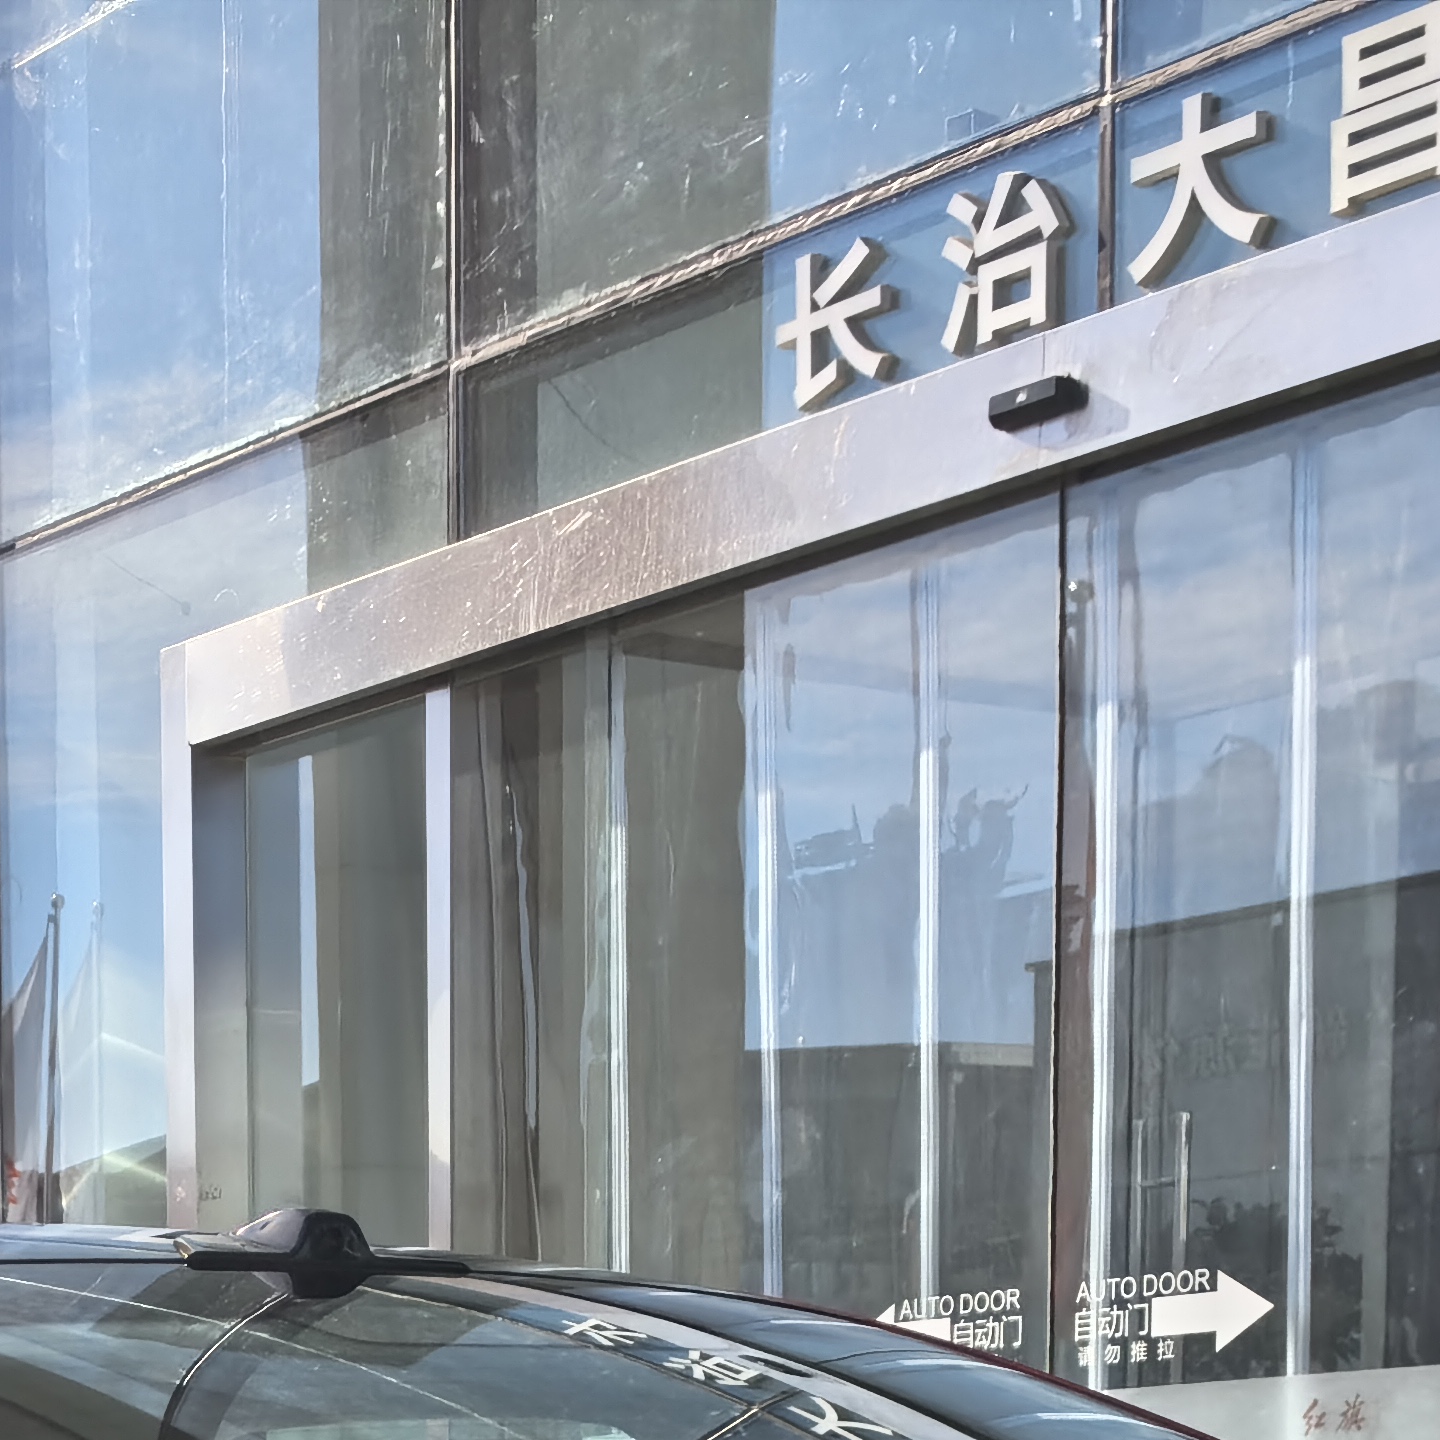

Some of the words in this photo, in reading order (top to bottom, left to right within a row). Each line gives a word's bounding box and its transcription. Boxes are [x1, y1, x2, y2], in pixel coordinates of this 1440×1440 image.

[1075, 1276, 1138, 1304] AUTO
[1143, 1268, 1211, 1298] DOOR
[899, 1294, 955, 1322] AUTO
[959, 1288, 1021, 1316] DOOR
[952, 1315, 1023, 1349] 自动门
[1074, 1304, 1150, 1343] 自动门
[1077, 1338, 1176, 1367] 请勿推拉
[1301, 1394, 1368, 1439] 红旗
